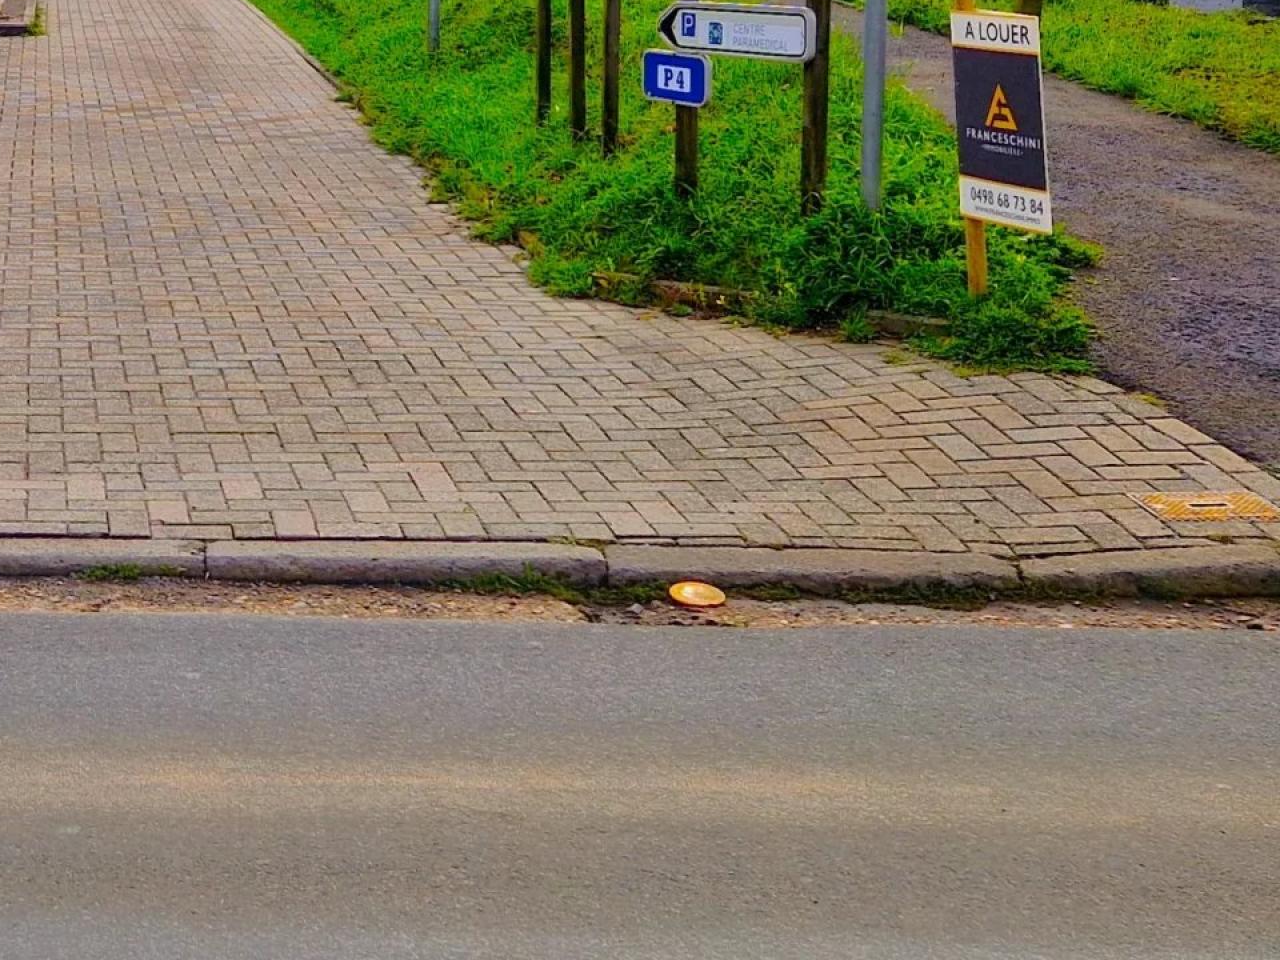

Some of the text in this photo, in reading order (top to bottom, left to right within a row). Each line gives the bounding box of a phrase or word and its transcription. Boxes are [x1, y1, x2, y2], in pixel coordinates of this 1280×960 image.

[684, 14, 694, 36] P
[733, 23, 766, 36] CENTRE
[965, 20, 1030, 45] A LOUER
[965, 127, 1041, 149] FRANCESCHINI
[970, 186, 994, 206] 0498
[997, 192, 1010, 209] 68
[1013, 195, 1026, 212] 73
[1030, 198, 1044, 215] 84
